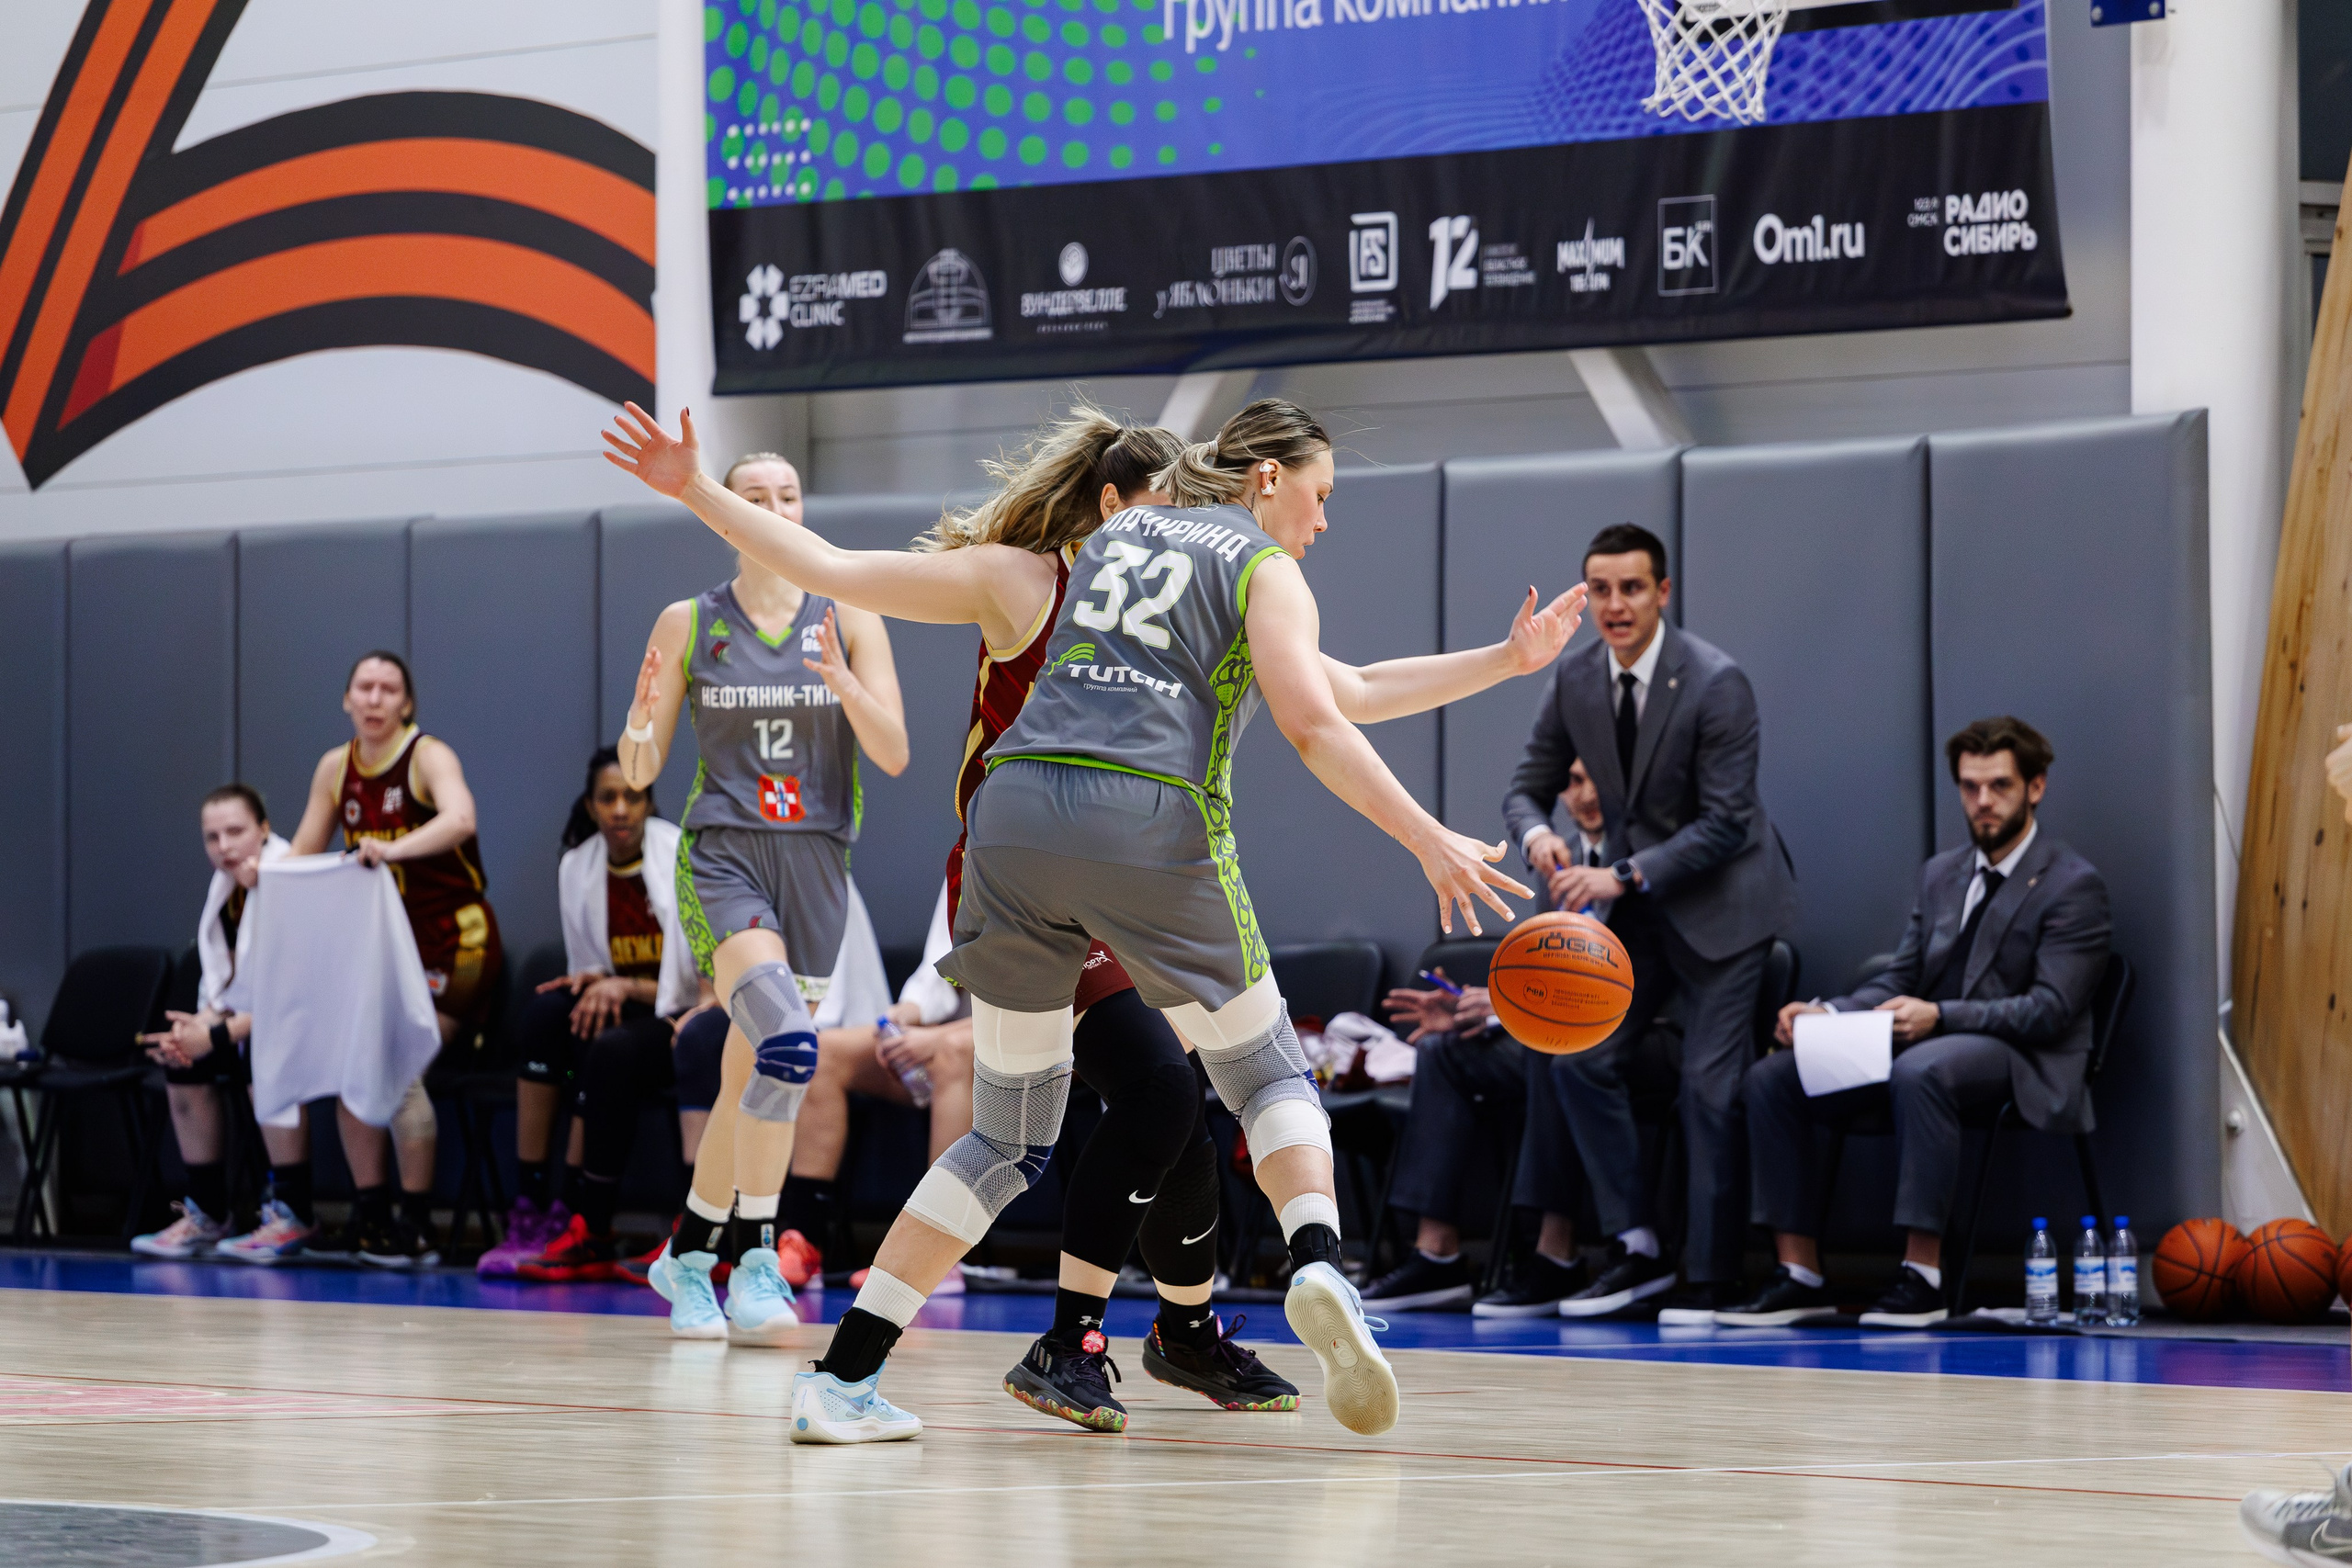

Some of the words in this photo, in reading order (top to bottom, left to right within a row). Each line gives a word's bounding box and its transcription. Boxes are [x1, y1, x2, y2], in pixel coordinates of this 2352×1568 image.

[1945, 188, 2029, 224] РАДИО
[1943, 220, 2038, 257] СИБИРЬ
[790, 299, 845, 328] CLINIC
[1072, 540, 1193, 650] 32
[752, 717, 795, 761] 12
[1526, 932, 1619, 969] JÖGEL
